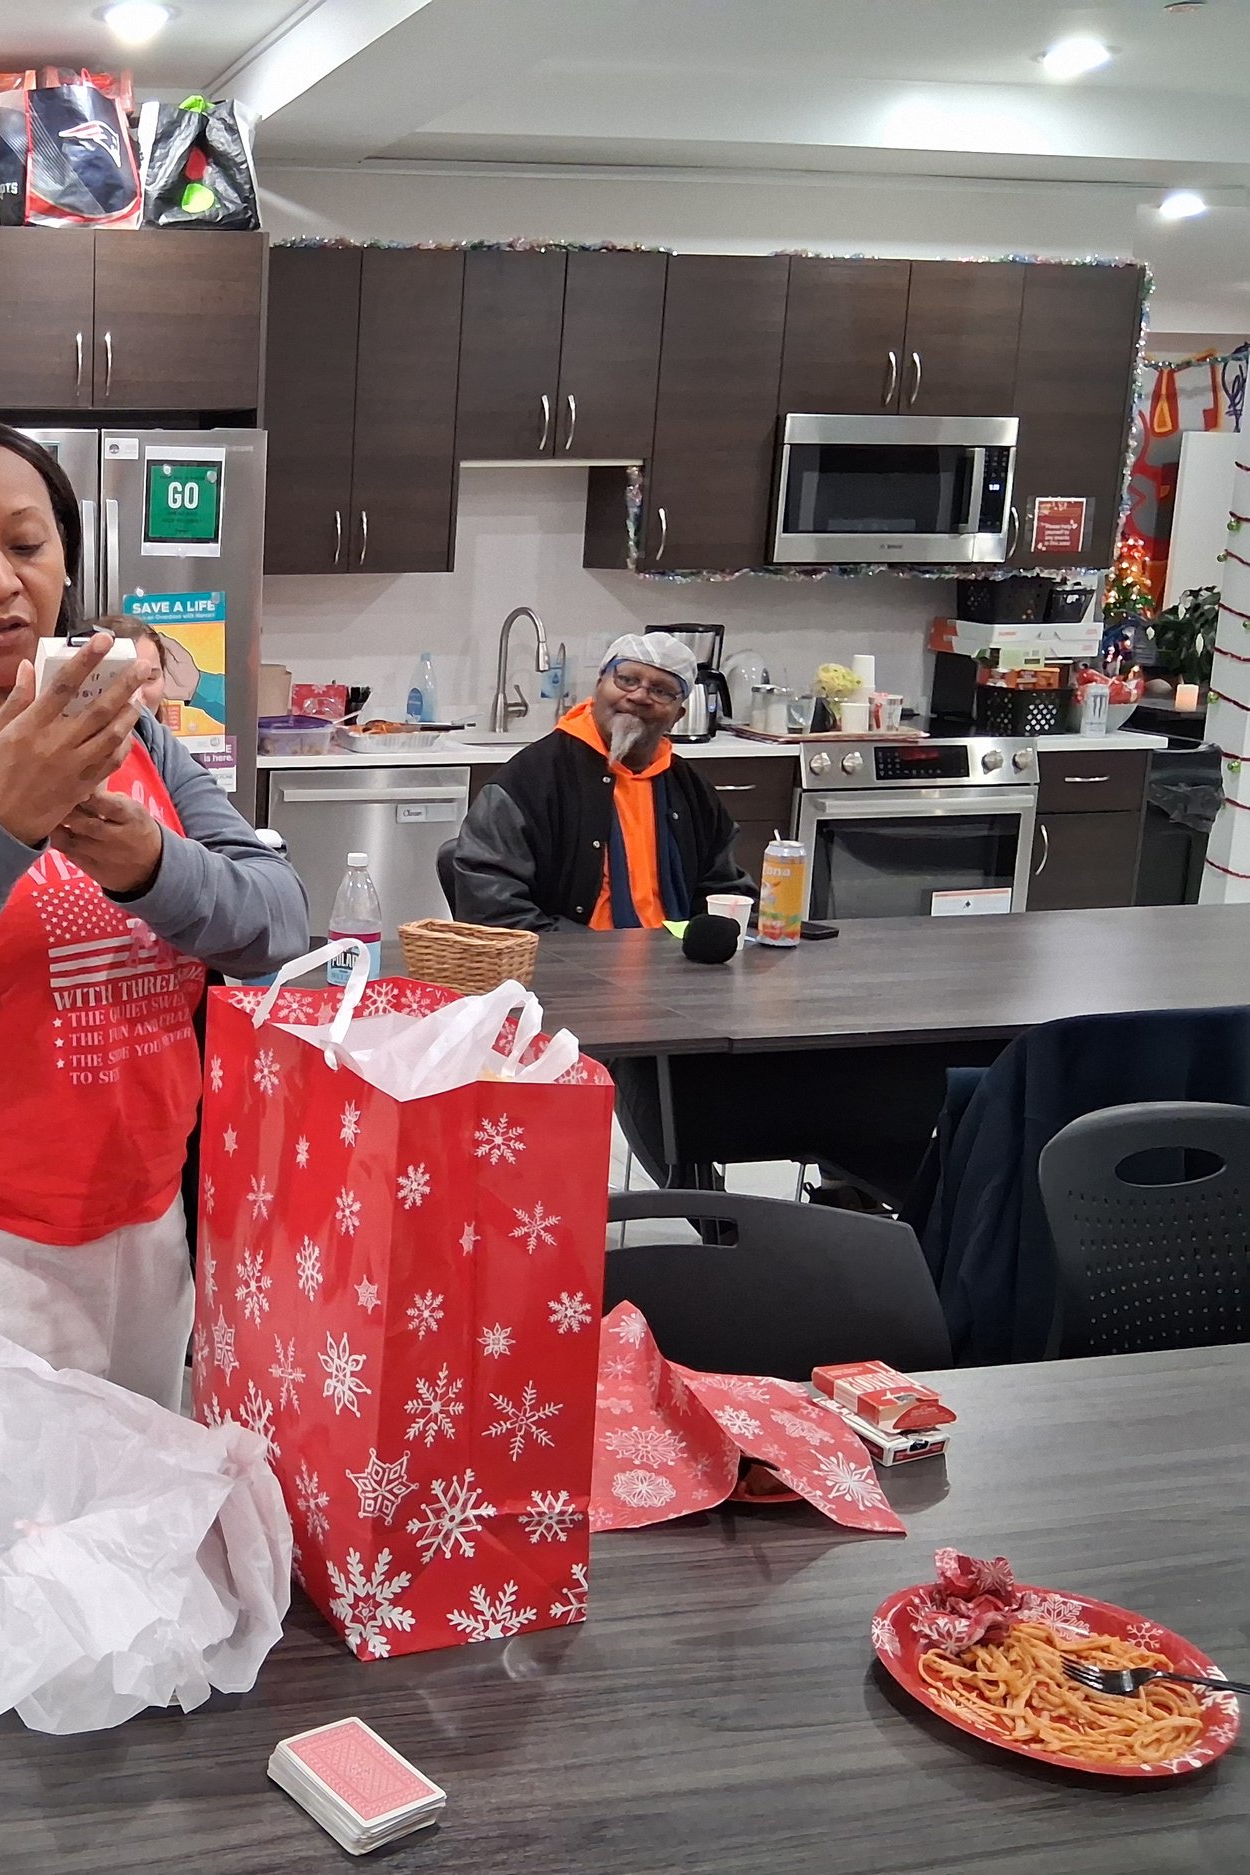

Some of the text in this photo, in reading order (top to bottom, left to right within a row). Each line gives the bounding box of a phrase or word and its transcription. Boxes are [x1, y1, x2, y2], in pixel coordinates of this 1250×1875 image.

[168, 481, 199, 509] GO
[132, 600, 215, 614] SAVE A LIFE
[53, 984, 114, 1011] WITH
[118, 973, 180, 1001] THREE
[68, 1009, 106, 1028] THE
[69, 1031, 105, 1048] THE
[109, 1024, 129, 1043] FUN
[69, 1053, 103, 1069] THE
[134, 1040, 161, 1057] YOU
[69, 1071, 93, 1086] TO
